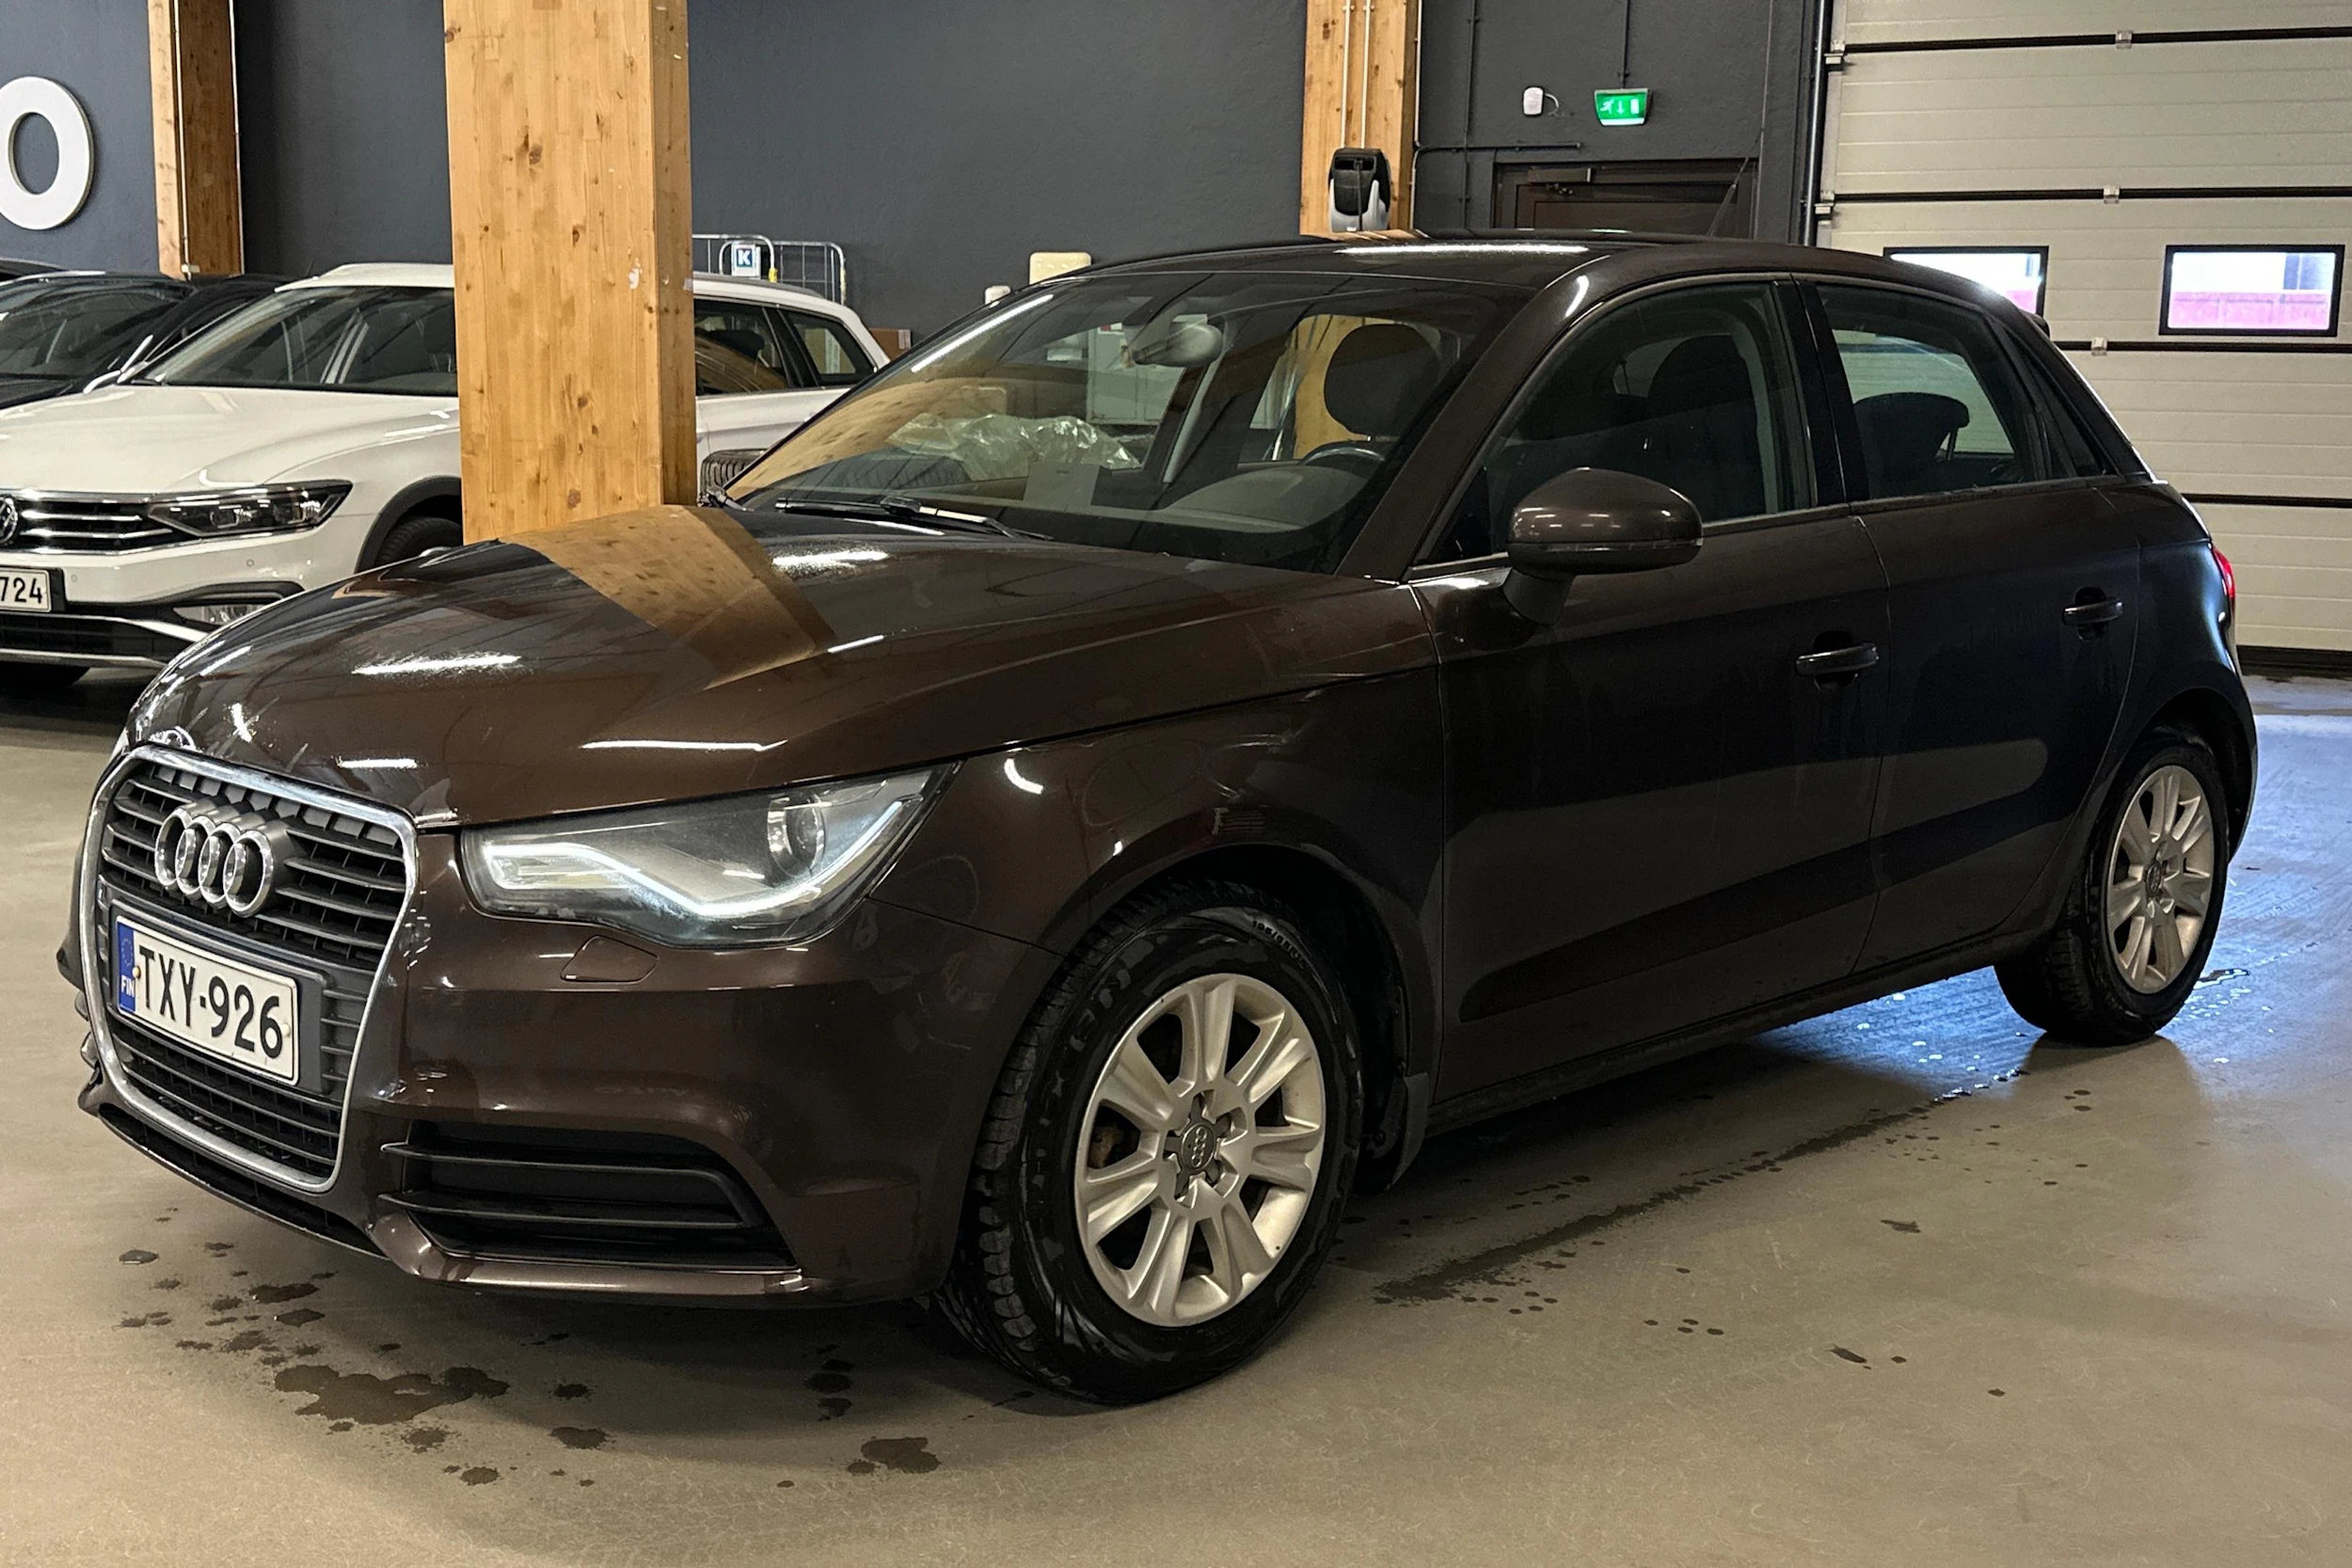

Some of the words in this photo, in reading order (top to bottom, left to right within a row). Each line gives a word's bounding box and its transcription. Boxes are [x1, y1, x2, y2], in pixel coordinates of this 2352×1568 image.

[738, 249, 752, 265] K
[0, 576, 42, 604] 724
[120, 975, 135, 999] FIN
[138, 944, 283, 1059] TXY-926
